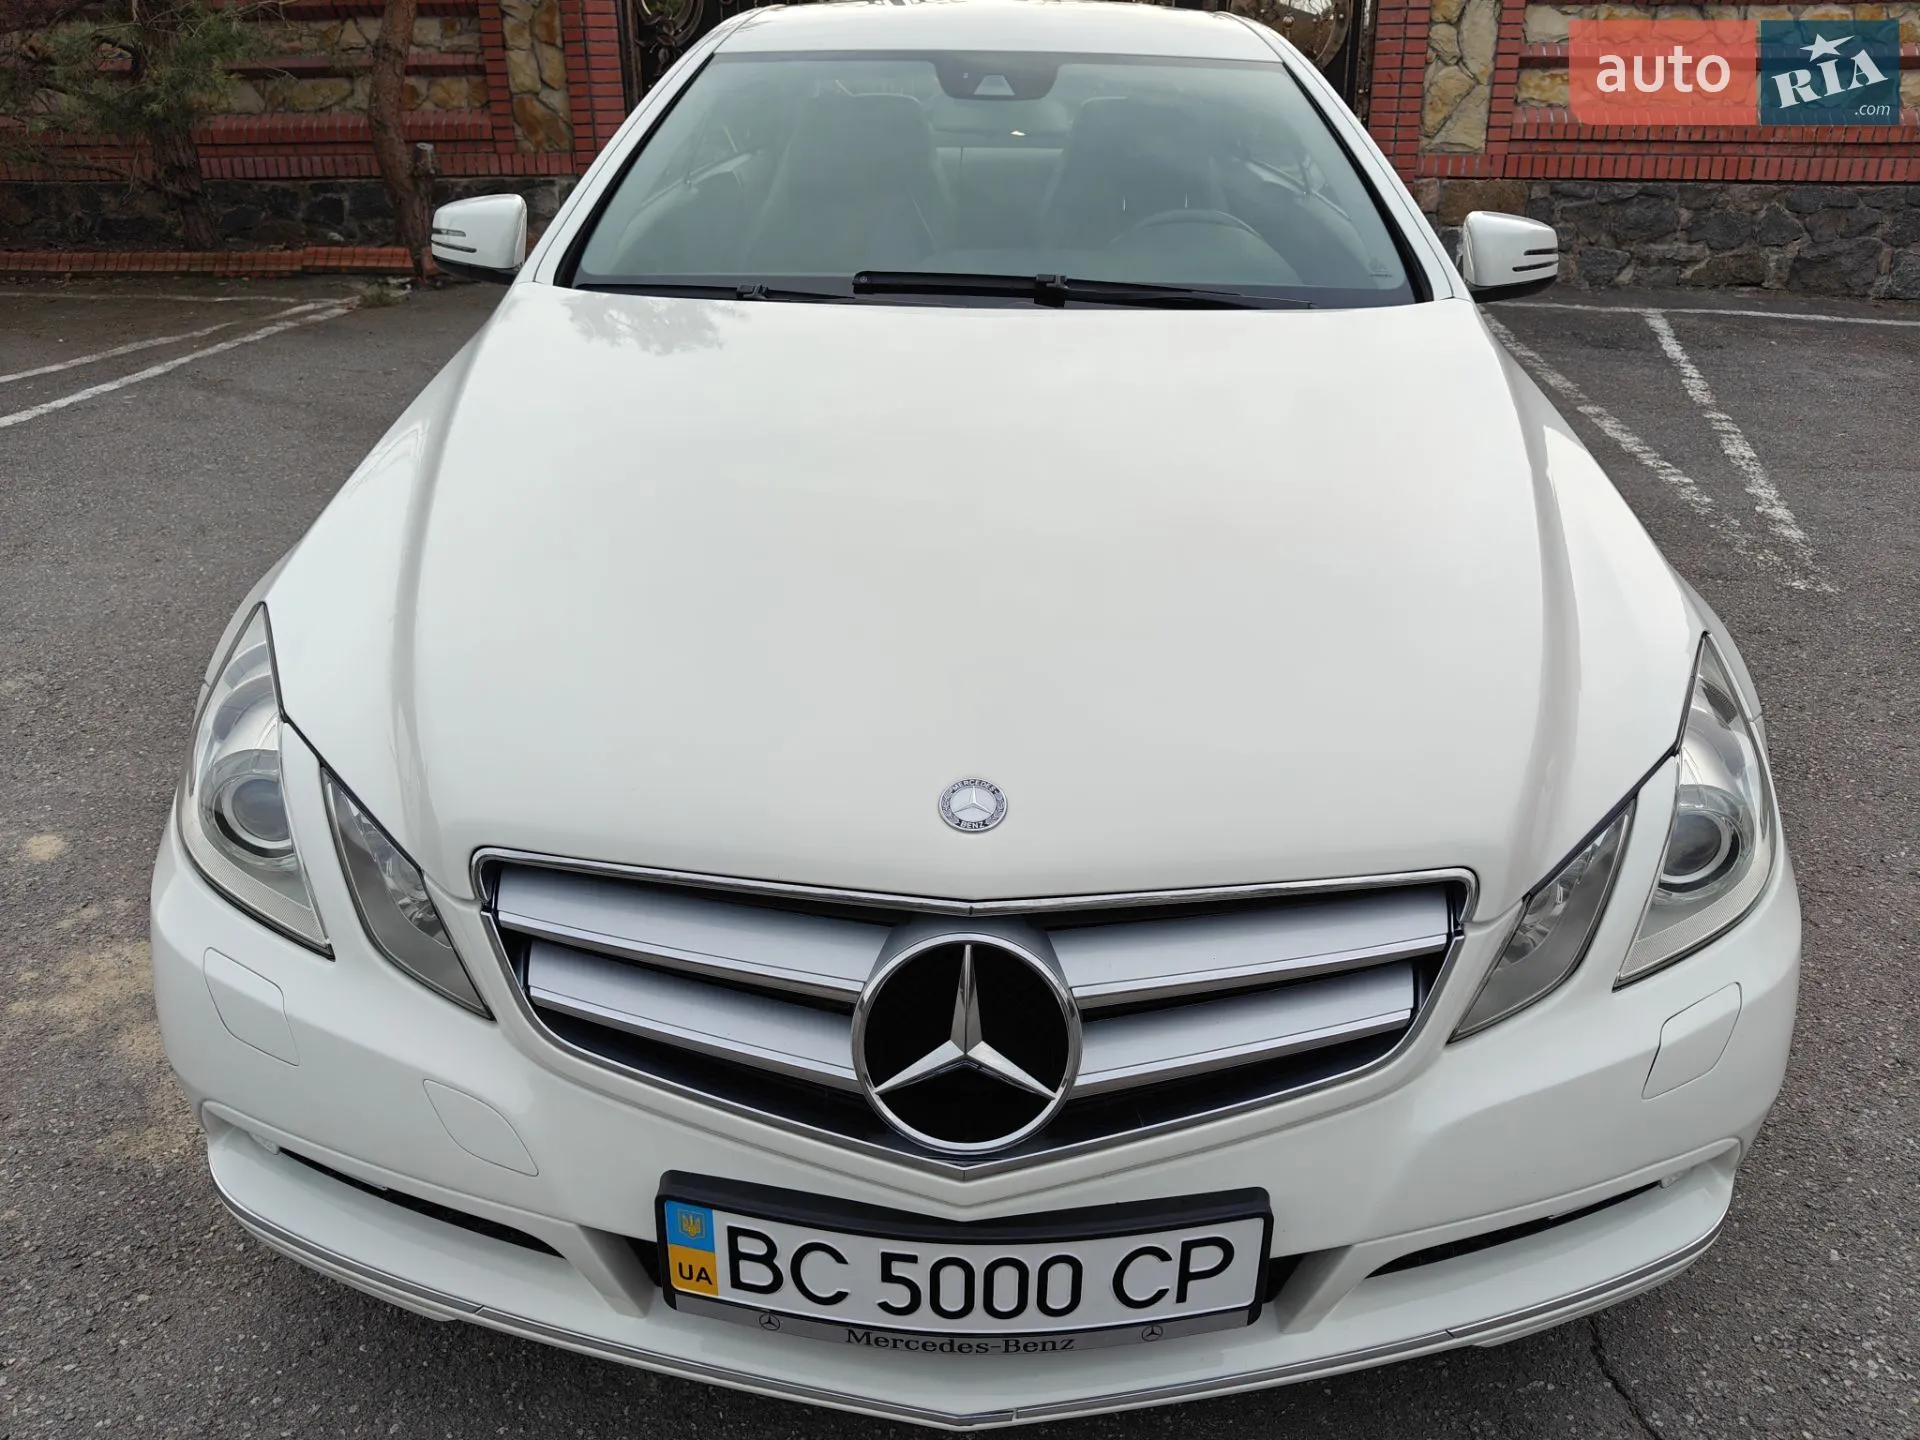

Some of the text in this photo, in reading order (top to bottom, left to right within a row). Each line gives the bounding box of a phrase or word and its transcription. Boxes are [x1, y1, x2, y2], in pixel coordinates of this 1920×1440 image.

[952, 779, 997, 793] MERCEDES
[960, 821, 985, 829] BENZ
[678, 1262, 713, 1285] UA
[726, 1225, 1235, 1319] BC 5000 CP
[845, 1328, 1075, 1353] Mercedes-Benz
